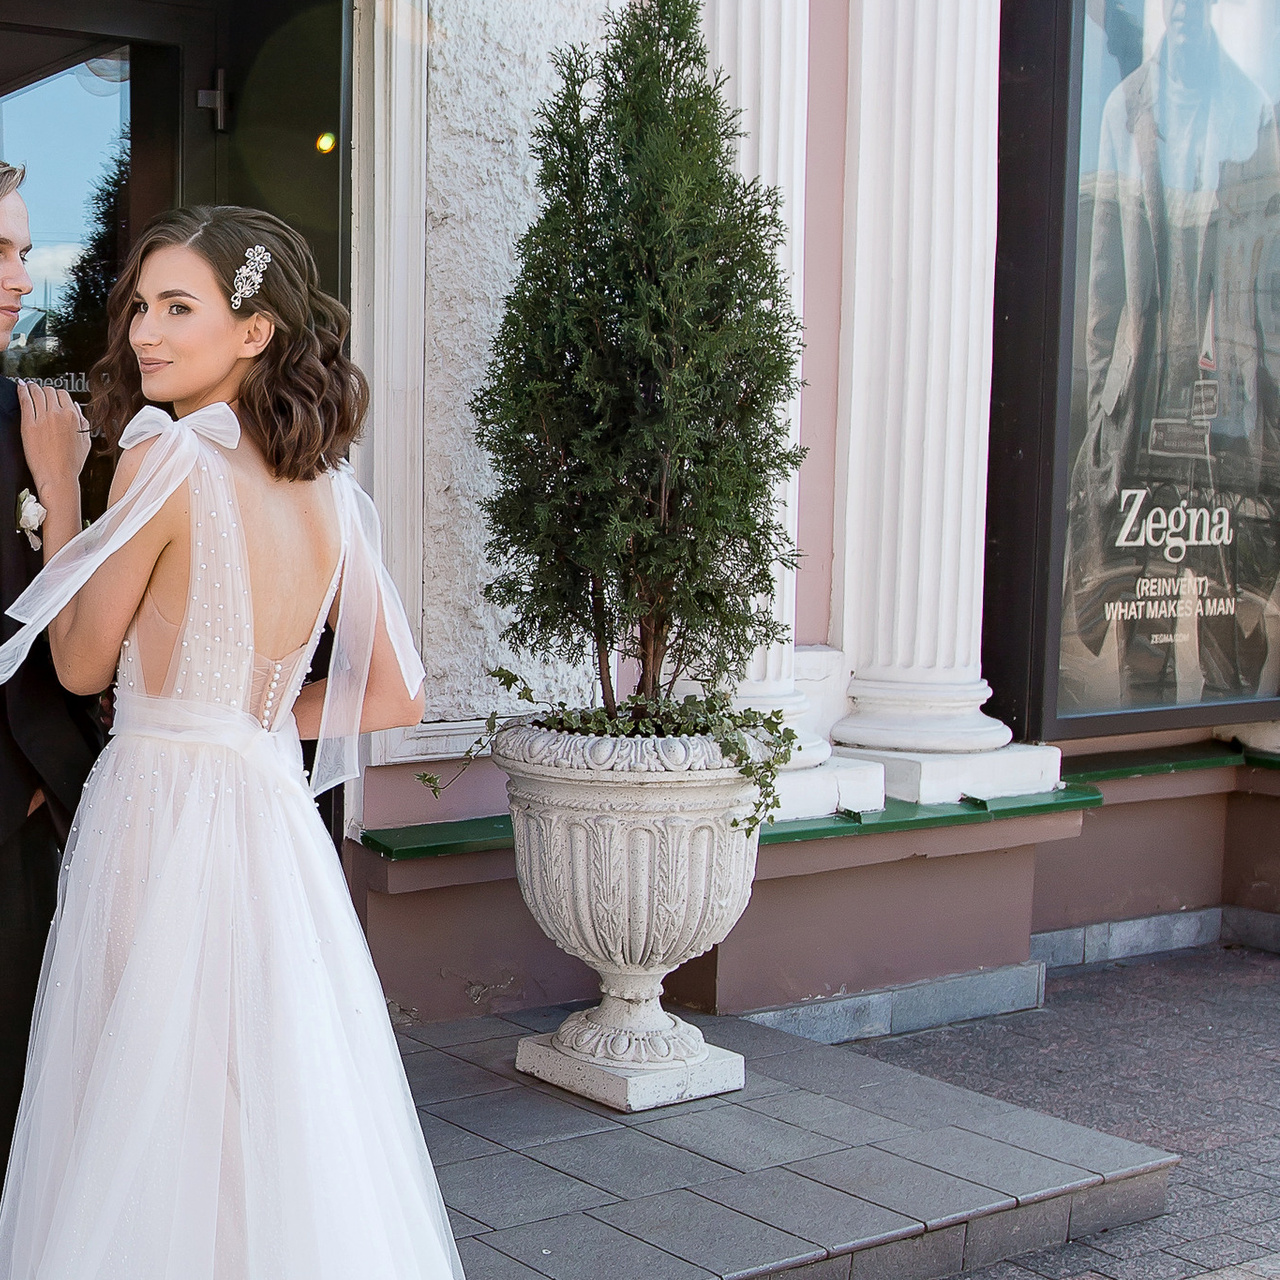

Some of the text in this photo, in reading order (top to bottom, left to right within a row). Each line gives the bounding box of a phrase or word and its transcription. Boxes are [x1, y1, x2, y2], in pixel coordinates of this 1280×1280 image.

[1115, 488, 1233, 563] Zegna
[1136, 576, 1209, 599] (REINVENT)
[1104, 597, 1235, 620] WHAT MAKES A MAN
